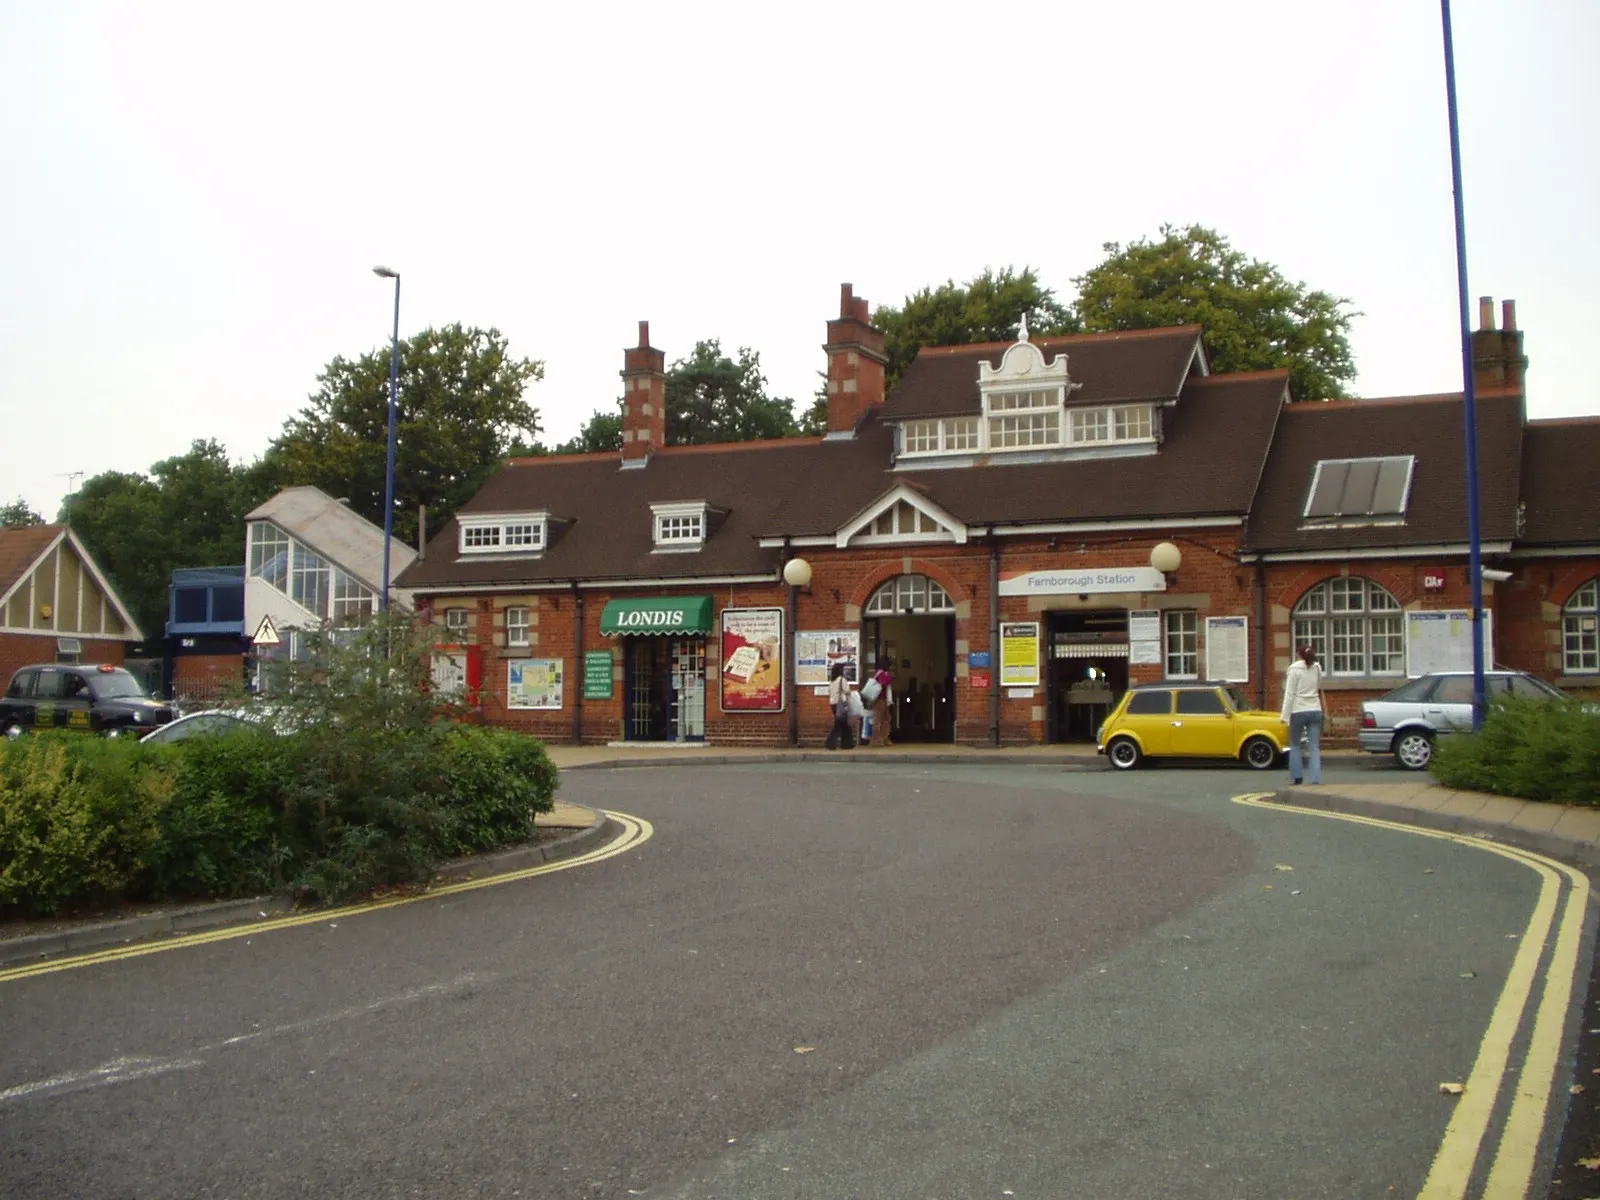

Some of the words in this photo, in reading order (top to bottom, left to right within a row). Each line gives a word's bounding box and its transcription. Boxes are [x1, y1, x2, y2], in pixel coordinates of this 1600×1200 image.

[1028, 576, 1094, 587] Farnborough
[1096, 573, 1136, 585] Station
[617, 610, 684, 627] LONDIS
